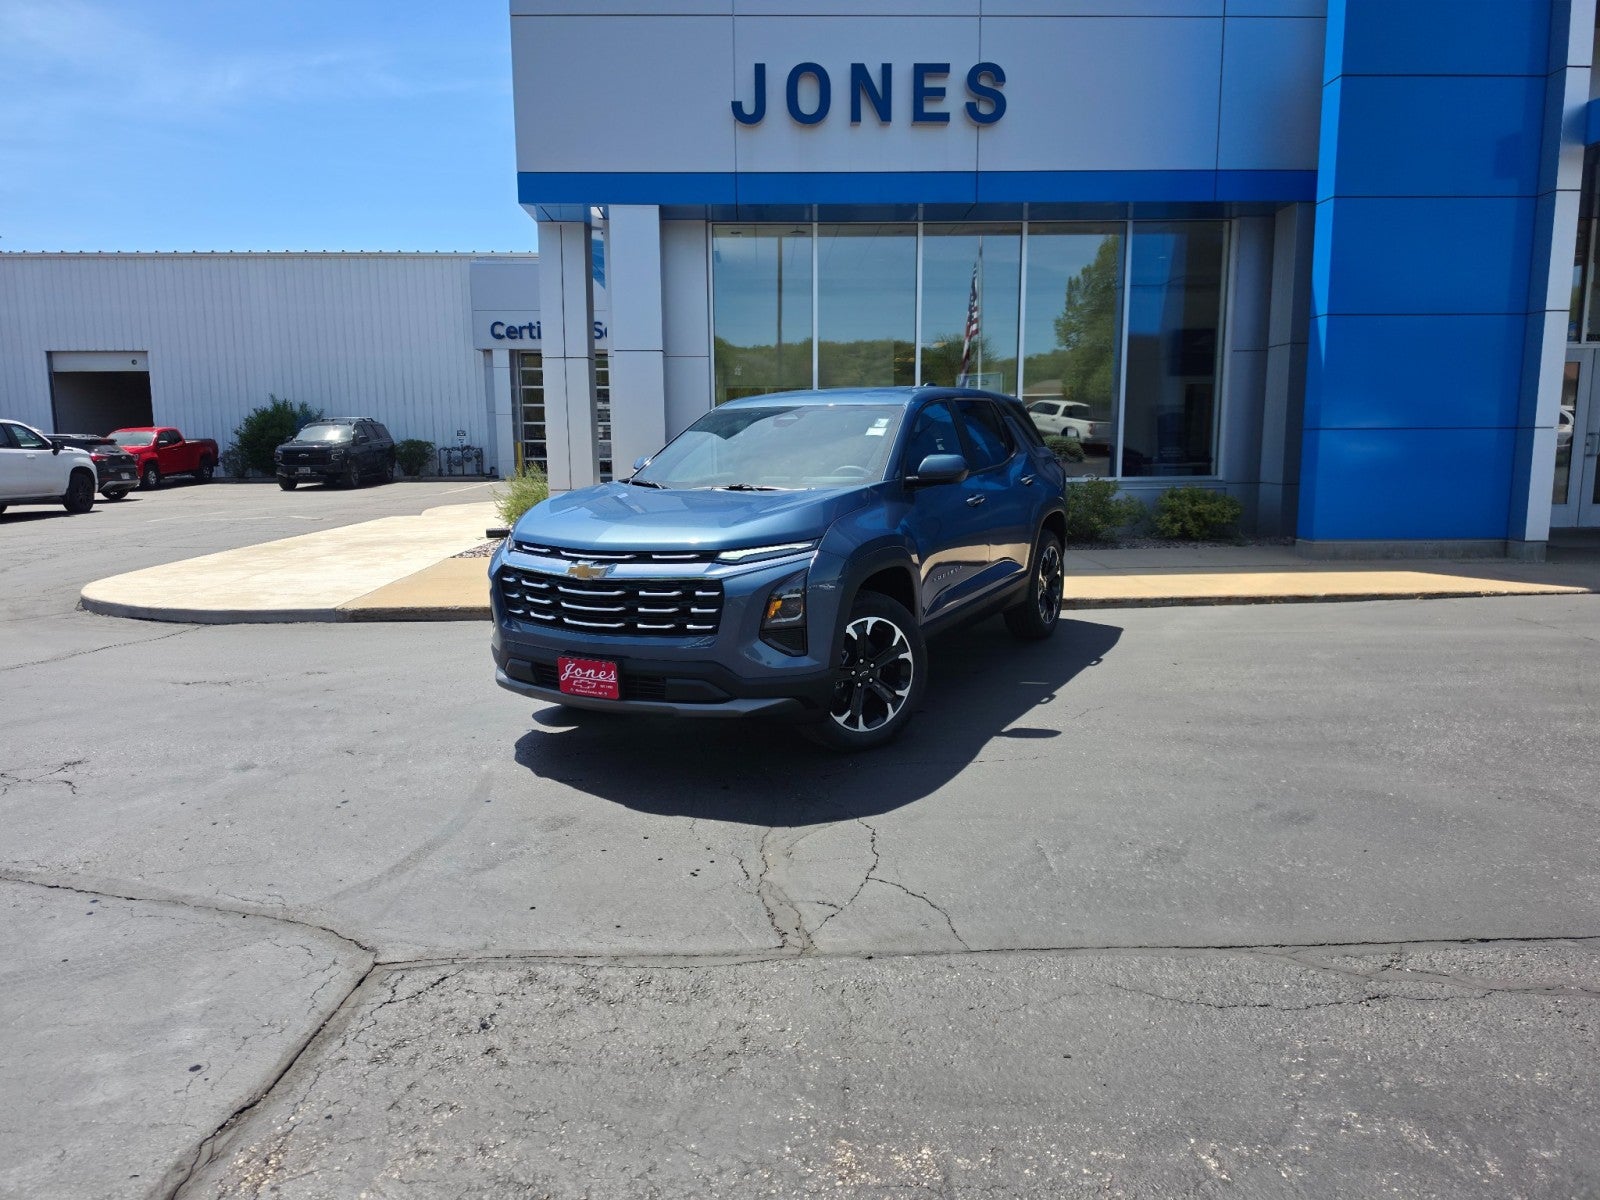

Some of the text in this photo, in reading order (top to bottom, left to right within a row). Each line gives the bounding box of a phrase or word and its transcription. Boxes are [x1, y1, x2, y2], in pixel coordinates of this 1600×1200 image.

[731, 62, 1007, 126] JONES
[490, 321, 542, 340] Certi
[561, 663, 616, 681] Jones
